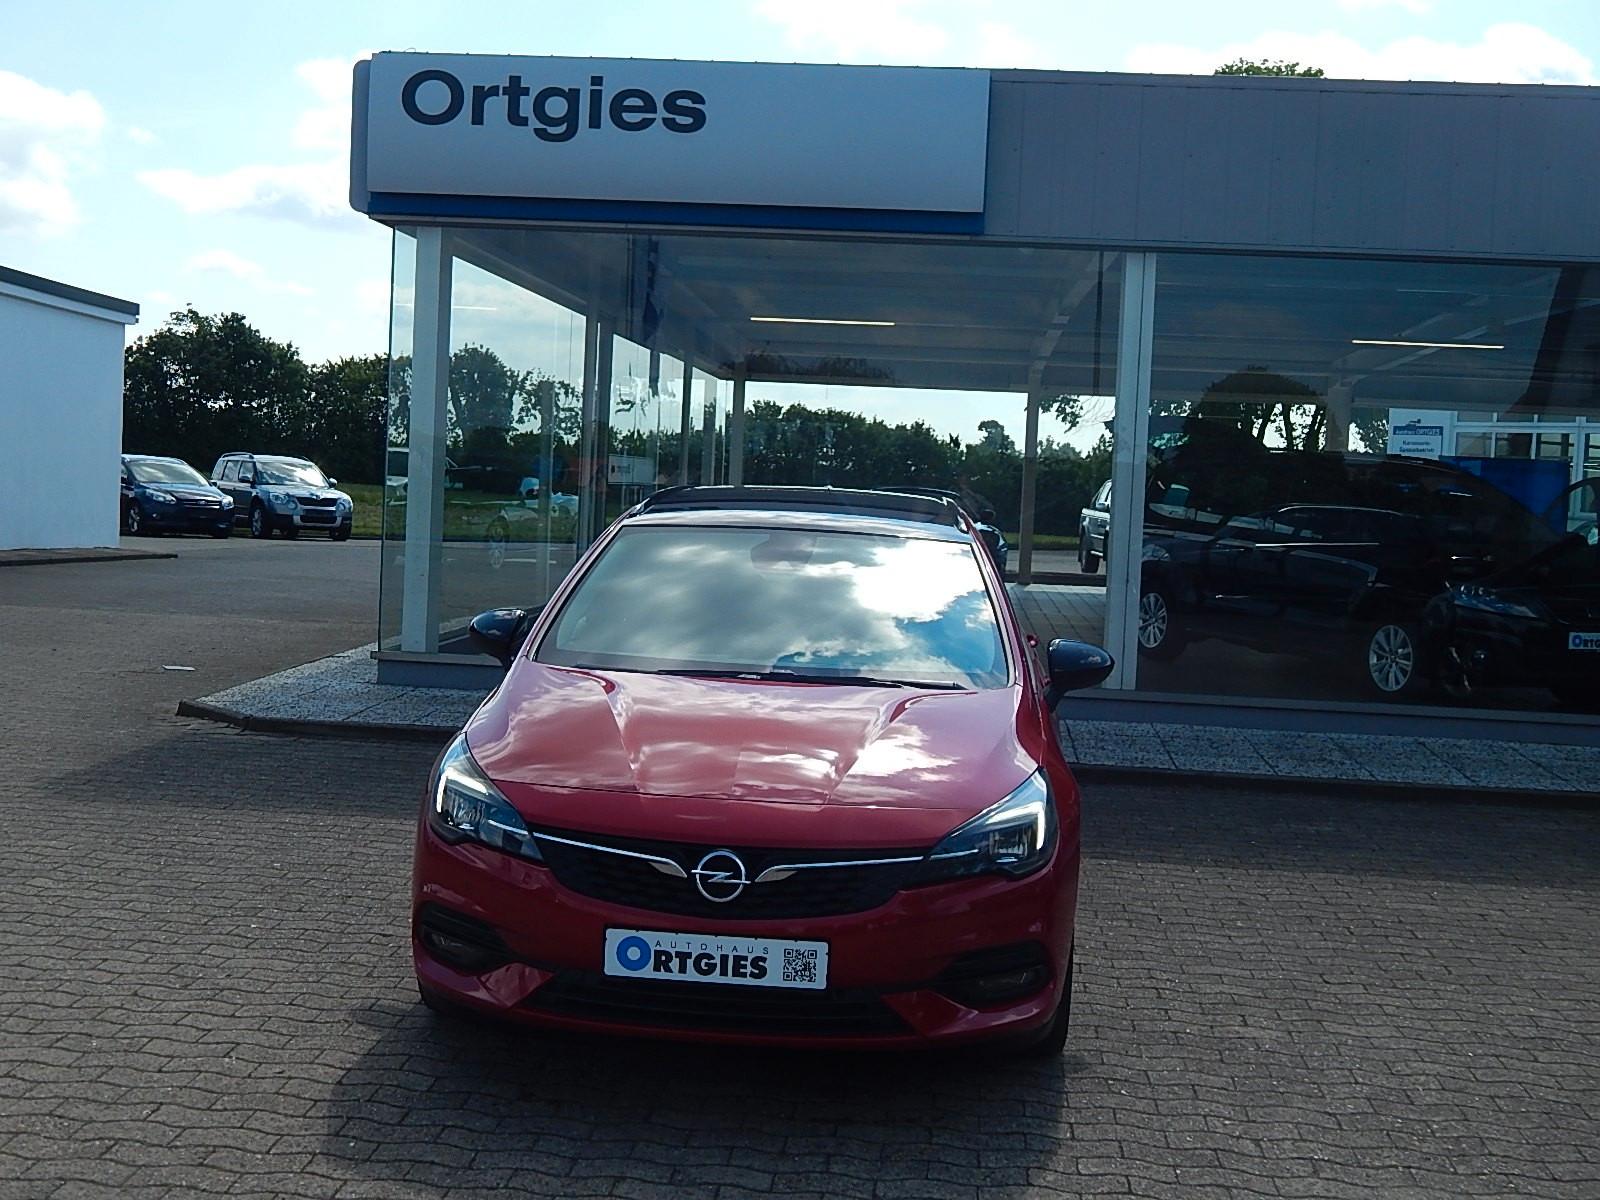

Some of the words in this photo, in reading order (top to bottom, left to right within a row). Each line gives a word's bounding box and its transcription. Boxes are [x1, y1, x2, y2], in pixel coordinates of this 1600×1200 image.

[401, 69, 707, 142] Ortgies
[616, 935, 768, 980] ORTGIES
[655, 939, 769, 955] AUTOHAUS
